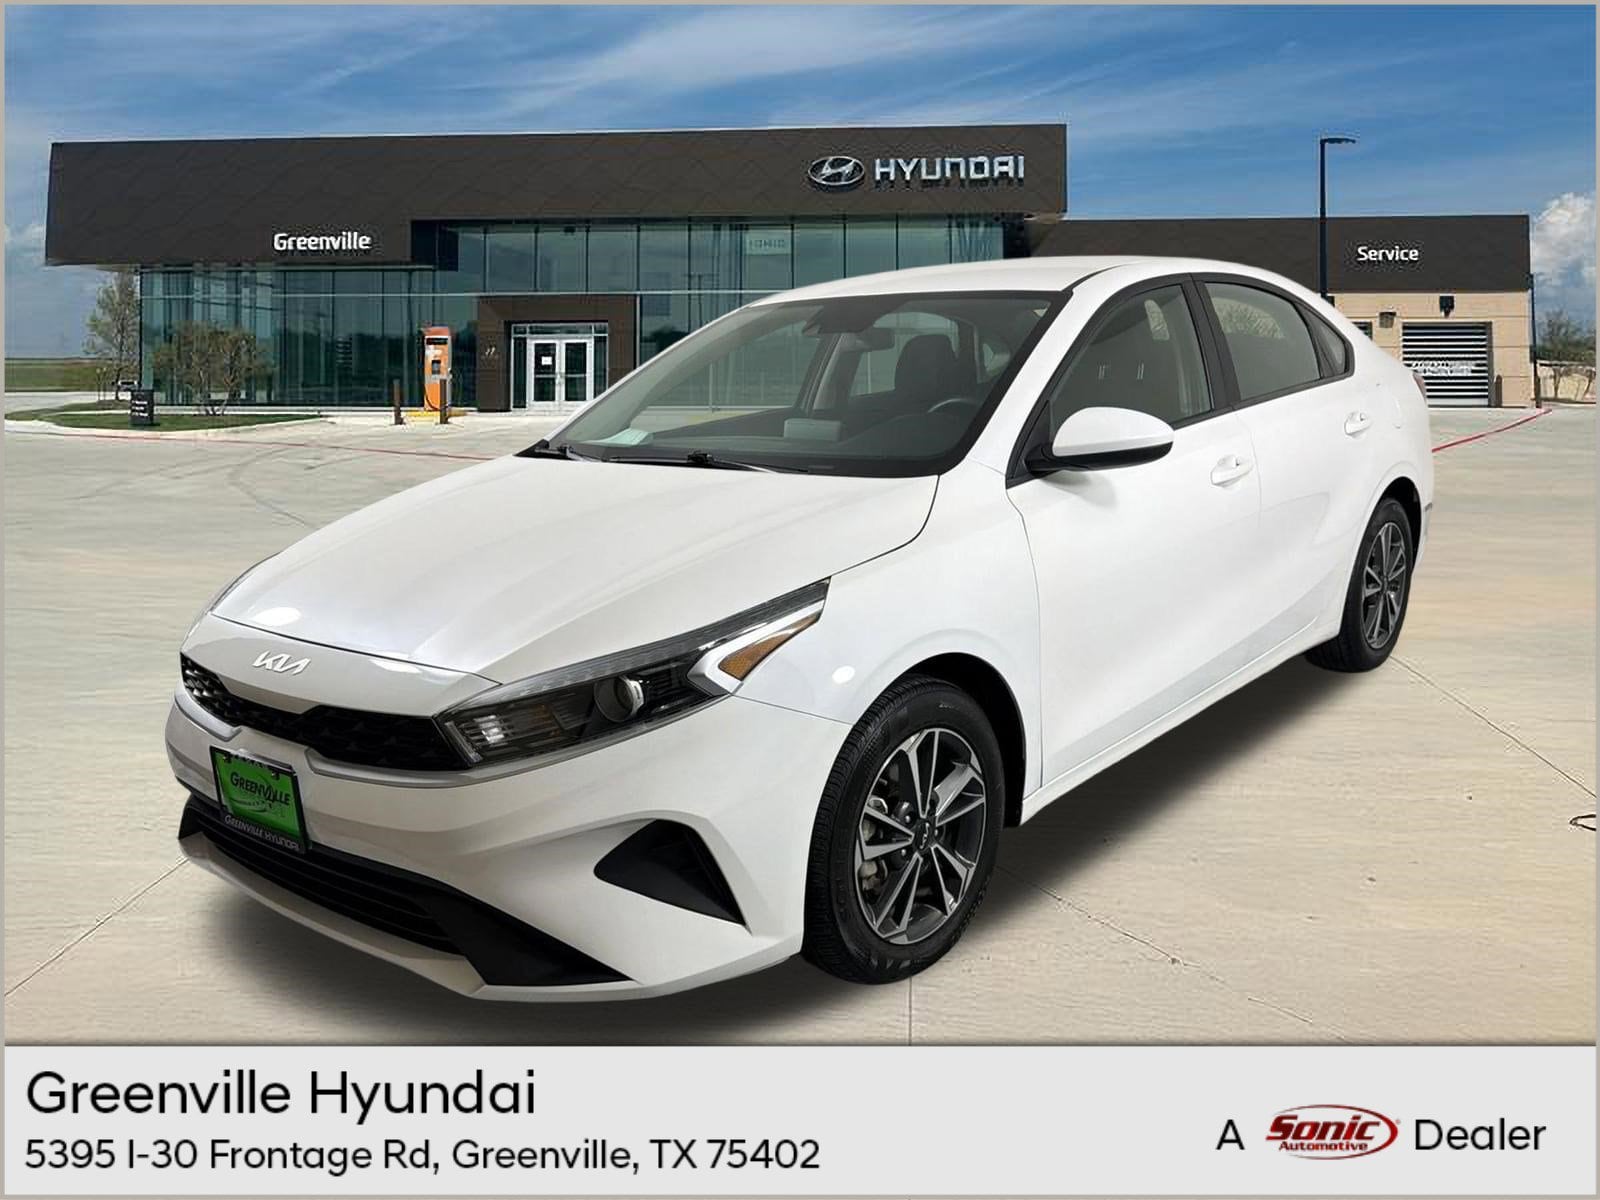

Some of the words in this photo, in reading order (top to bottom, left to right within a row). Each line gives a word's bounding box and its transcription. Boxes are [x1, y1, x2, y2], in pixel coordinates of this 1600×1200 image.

[875, 155, 1025, 181] HYUNDAI
[273, 231, 372, 252] Greenville
[1356, 246, 1420, 262] Service
[252, 650, 311, 676] KIA
